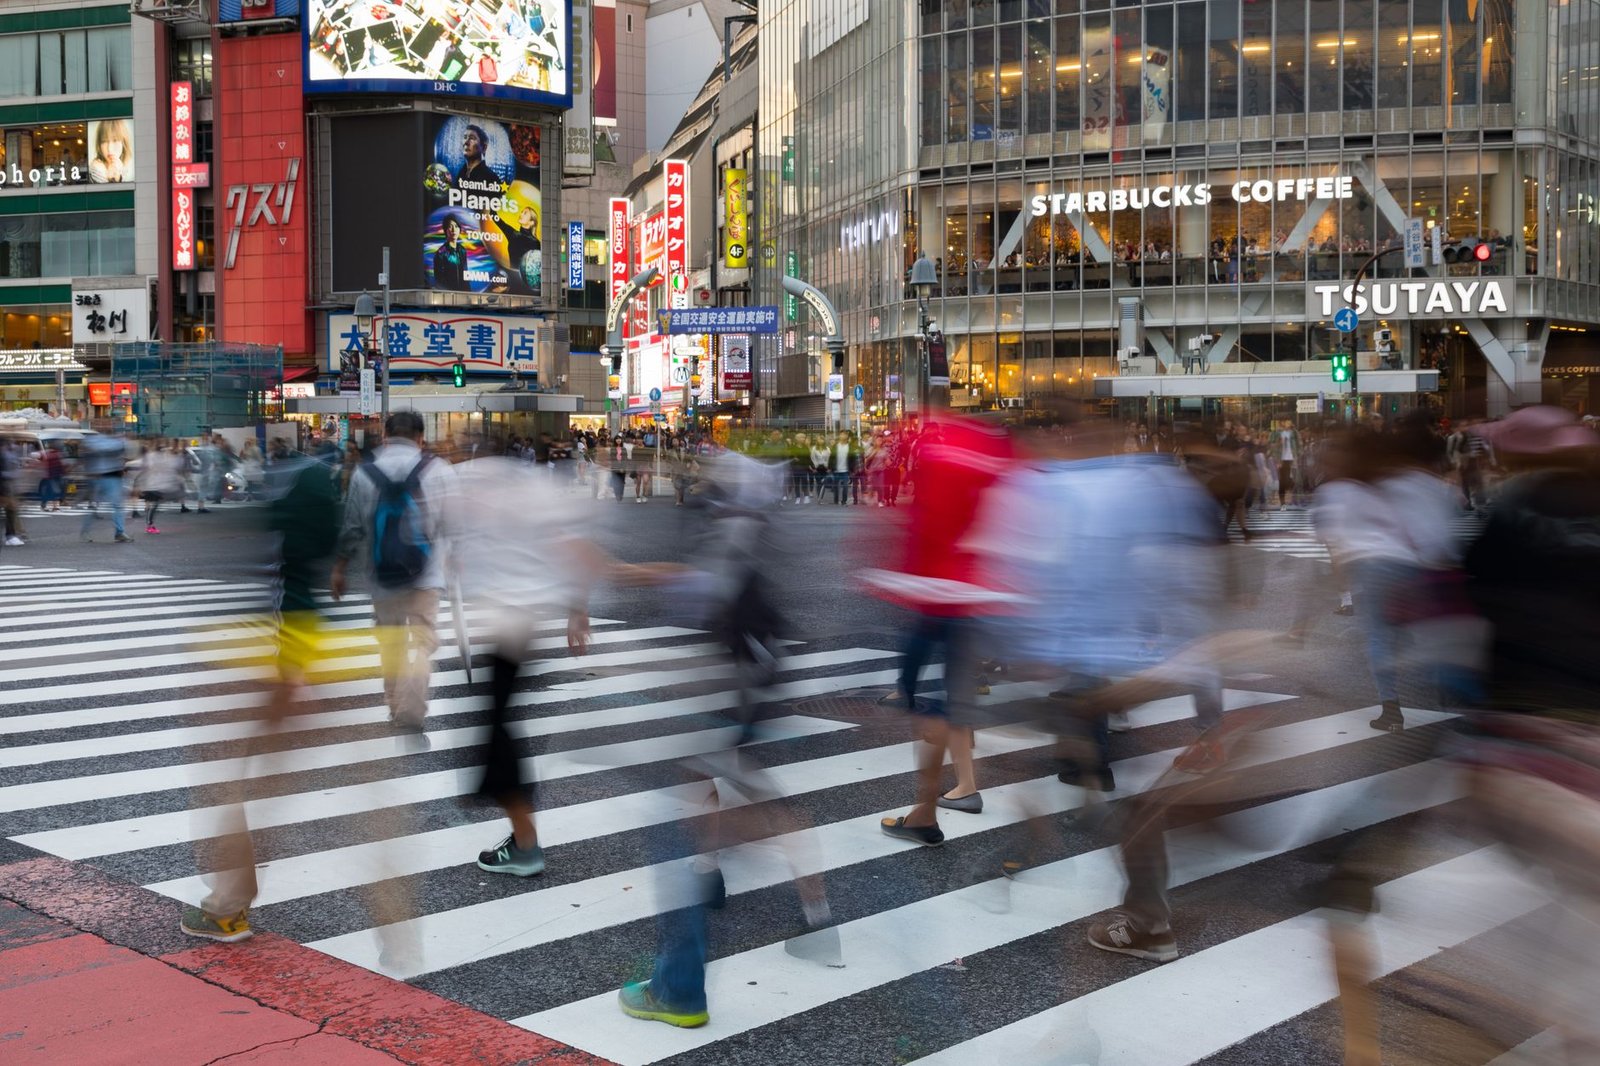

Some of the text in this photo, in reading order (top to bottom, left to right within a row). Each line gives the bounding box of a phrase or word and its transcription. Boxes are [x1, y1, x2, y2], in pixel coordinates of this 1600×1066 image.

[434, 82, 456, 92] DHC
[458, 178, 500, 192] teamLab
[448, 189, 518, 214] Planets
[1032, 176, 1353, 217] STARBUCKS COFFEE
[224, 158, 300, 268] クスリ
[470, 212, 500, 222] TOKYO
[669, 172, 684, 251] カラオケ
[466, 230, 503, 242] TOYOSU
[464, 270, 507, 284] DMM.com
[75, 294, 102, 306] うなぎ
[1314, 280, 1508, 316] TSUTAYA
[672, 310, 774, 326] 全国交通安全運動実施中
[340, 322, 535, 361] 大盛堂書店
[1109, 926, 1132, 947] N
